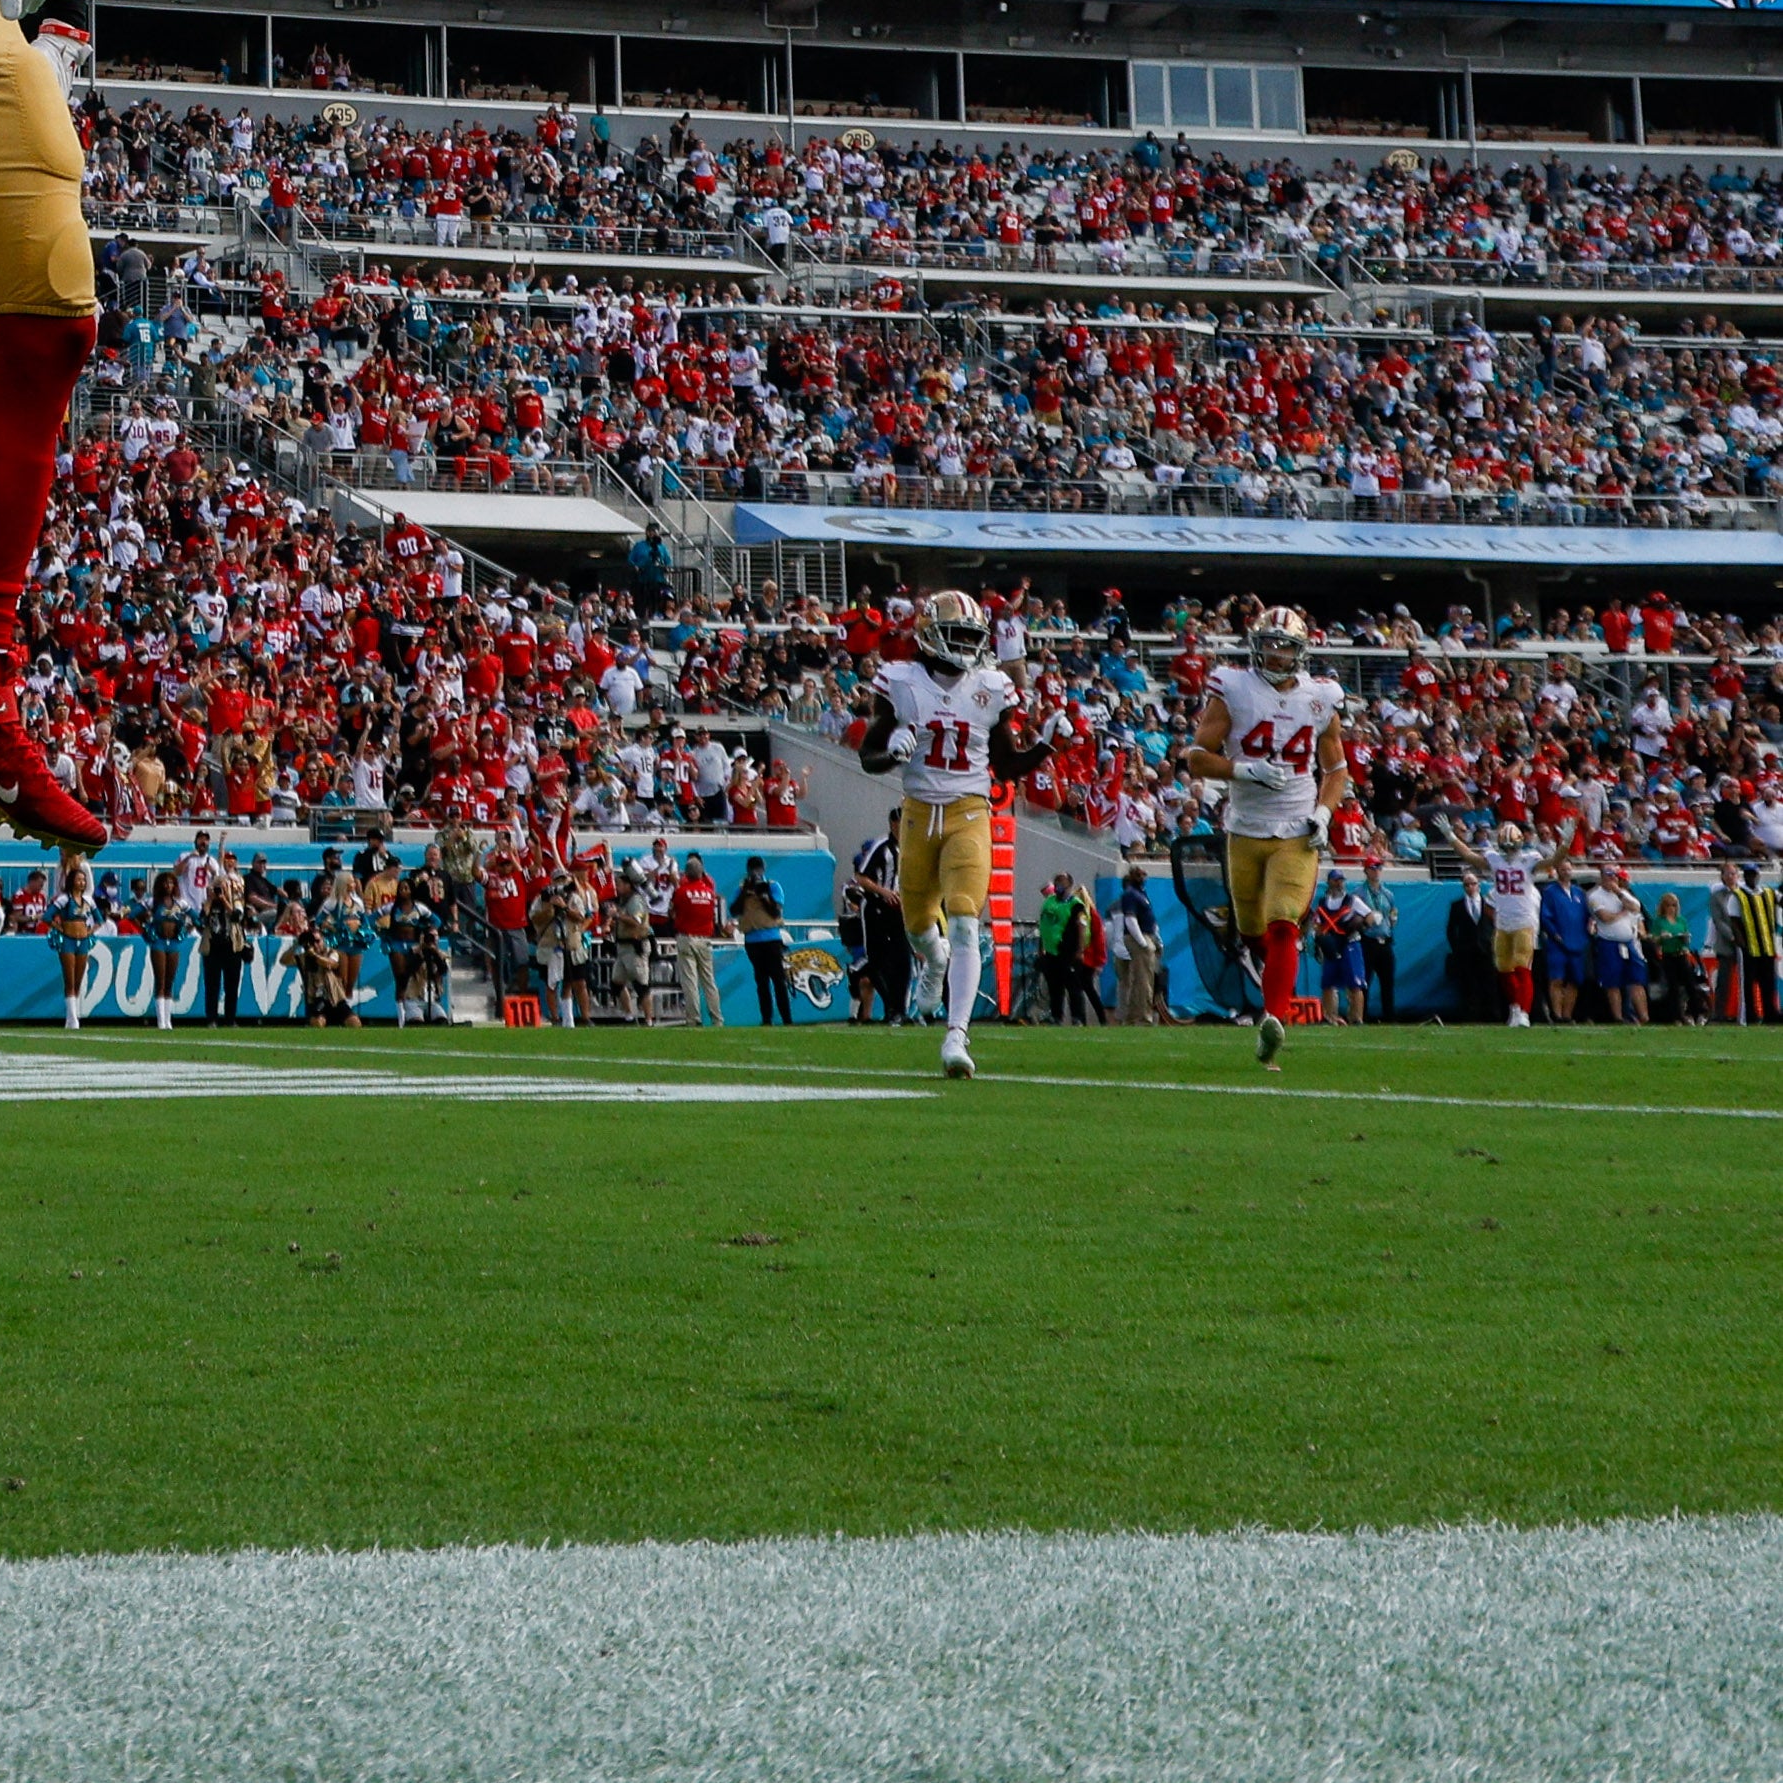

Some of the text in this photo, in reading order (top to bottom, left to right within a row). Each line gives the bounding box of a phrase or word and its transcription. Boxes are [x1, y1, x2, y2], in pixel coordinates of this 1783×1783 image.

[327, 107, 353, 123] 235
[877, 286, 892, 299] 97
[411, 304, 426, 320] 28
[139, 328, 150, 342] 16
[1161, 400, 1175, 414] 16
[131, 425, 144, 439] 10
[155, 428, 170, 443] 85
[1004, 521, 1628, 556] Gallagher INSURANCE
[297, 555, 308, 569] 10
[427, 581, 436, 595] 5
[195, 742, 205, 760] 7
[923, 720, 973, 773] 11
[1241, 721, 1316, 776] 44
[477, 805, 488, 821] 6
[194, 869, 206, 887] 8
[1496, 869, 1523, 895] 82
[510, 1001, 535, 1025] 10
[1293, 1001, 1318, 1019] 20
